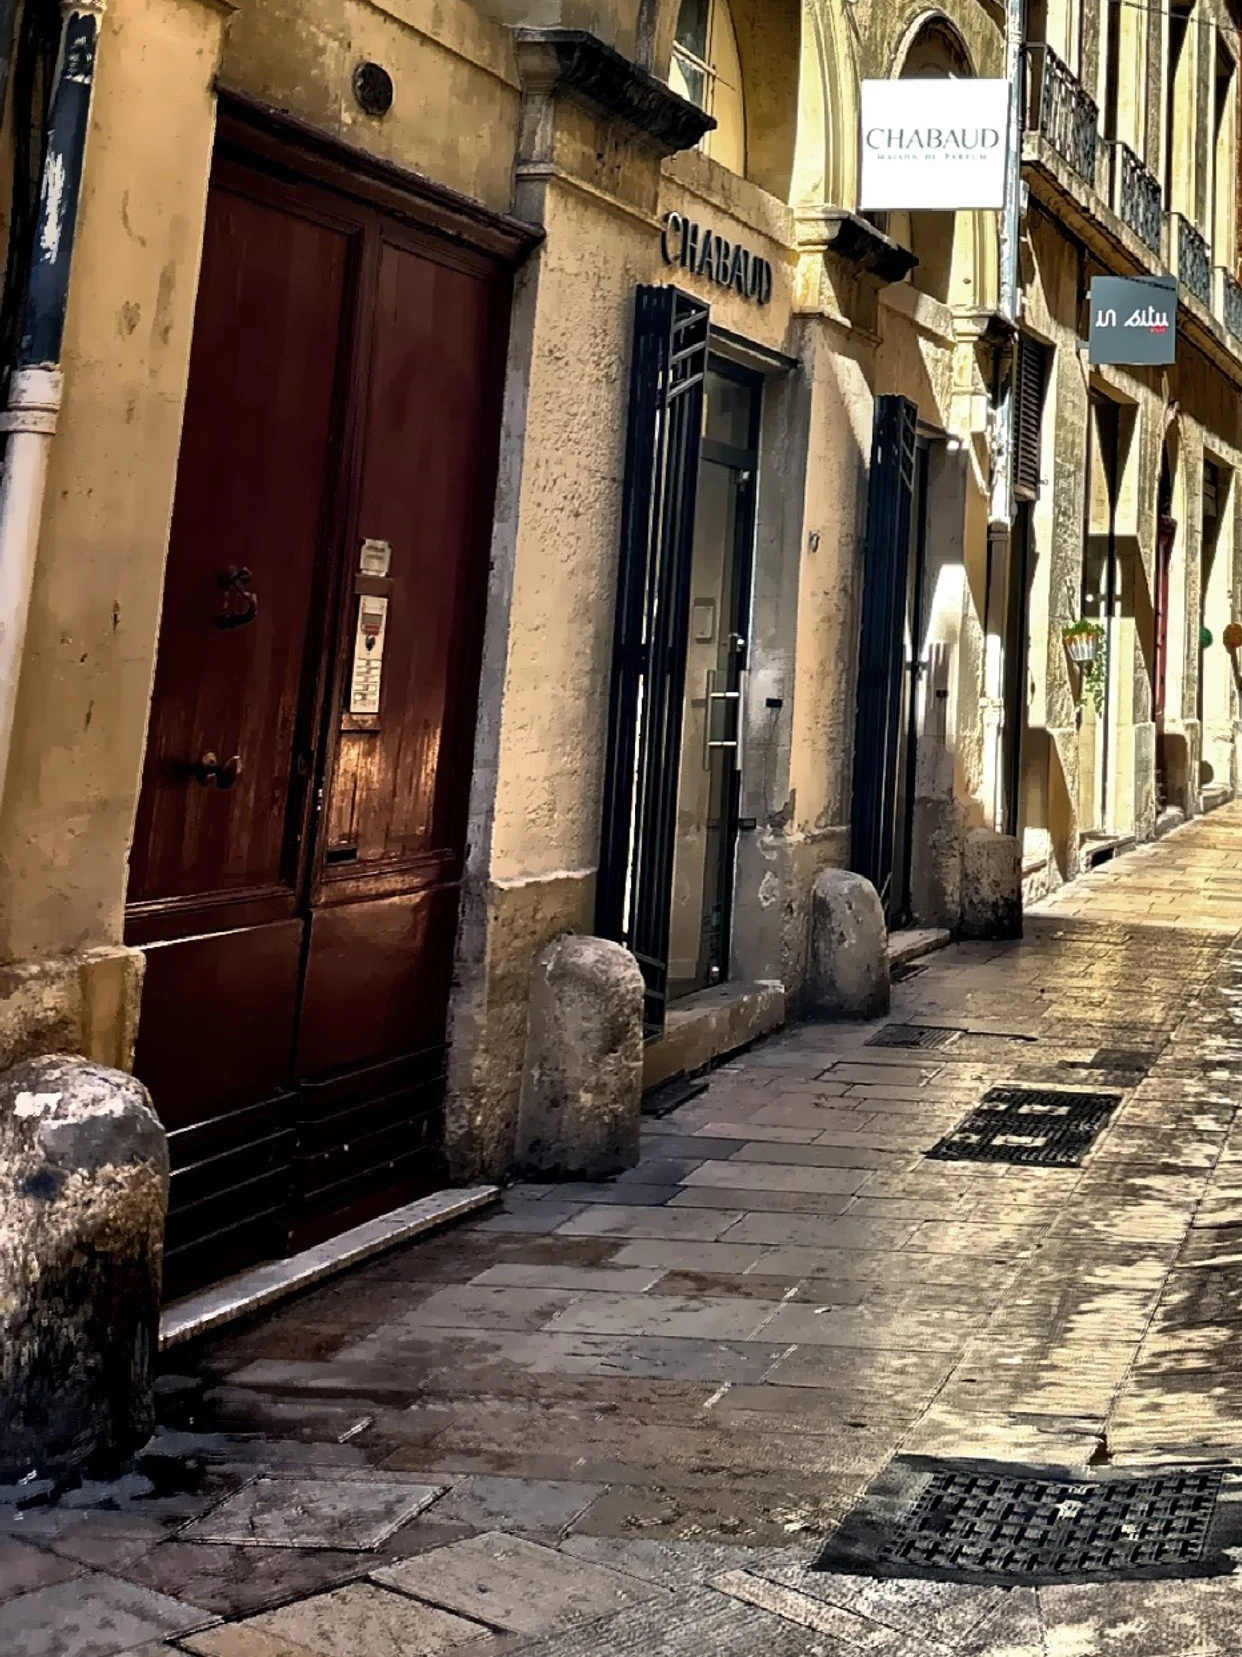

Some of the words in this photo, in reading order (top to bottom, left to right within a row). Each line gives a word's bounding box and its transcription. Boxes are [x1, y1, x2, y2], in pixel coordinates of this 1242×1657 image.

[866, 128, 1000, 150] CHABAUD
[661, 211, 772, 305] CHABAUD
[1095, 309, 1117, 328] in
[1124, 305, 1169, 328] situ
